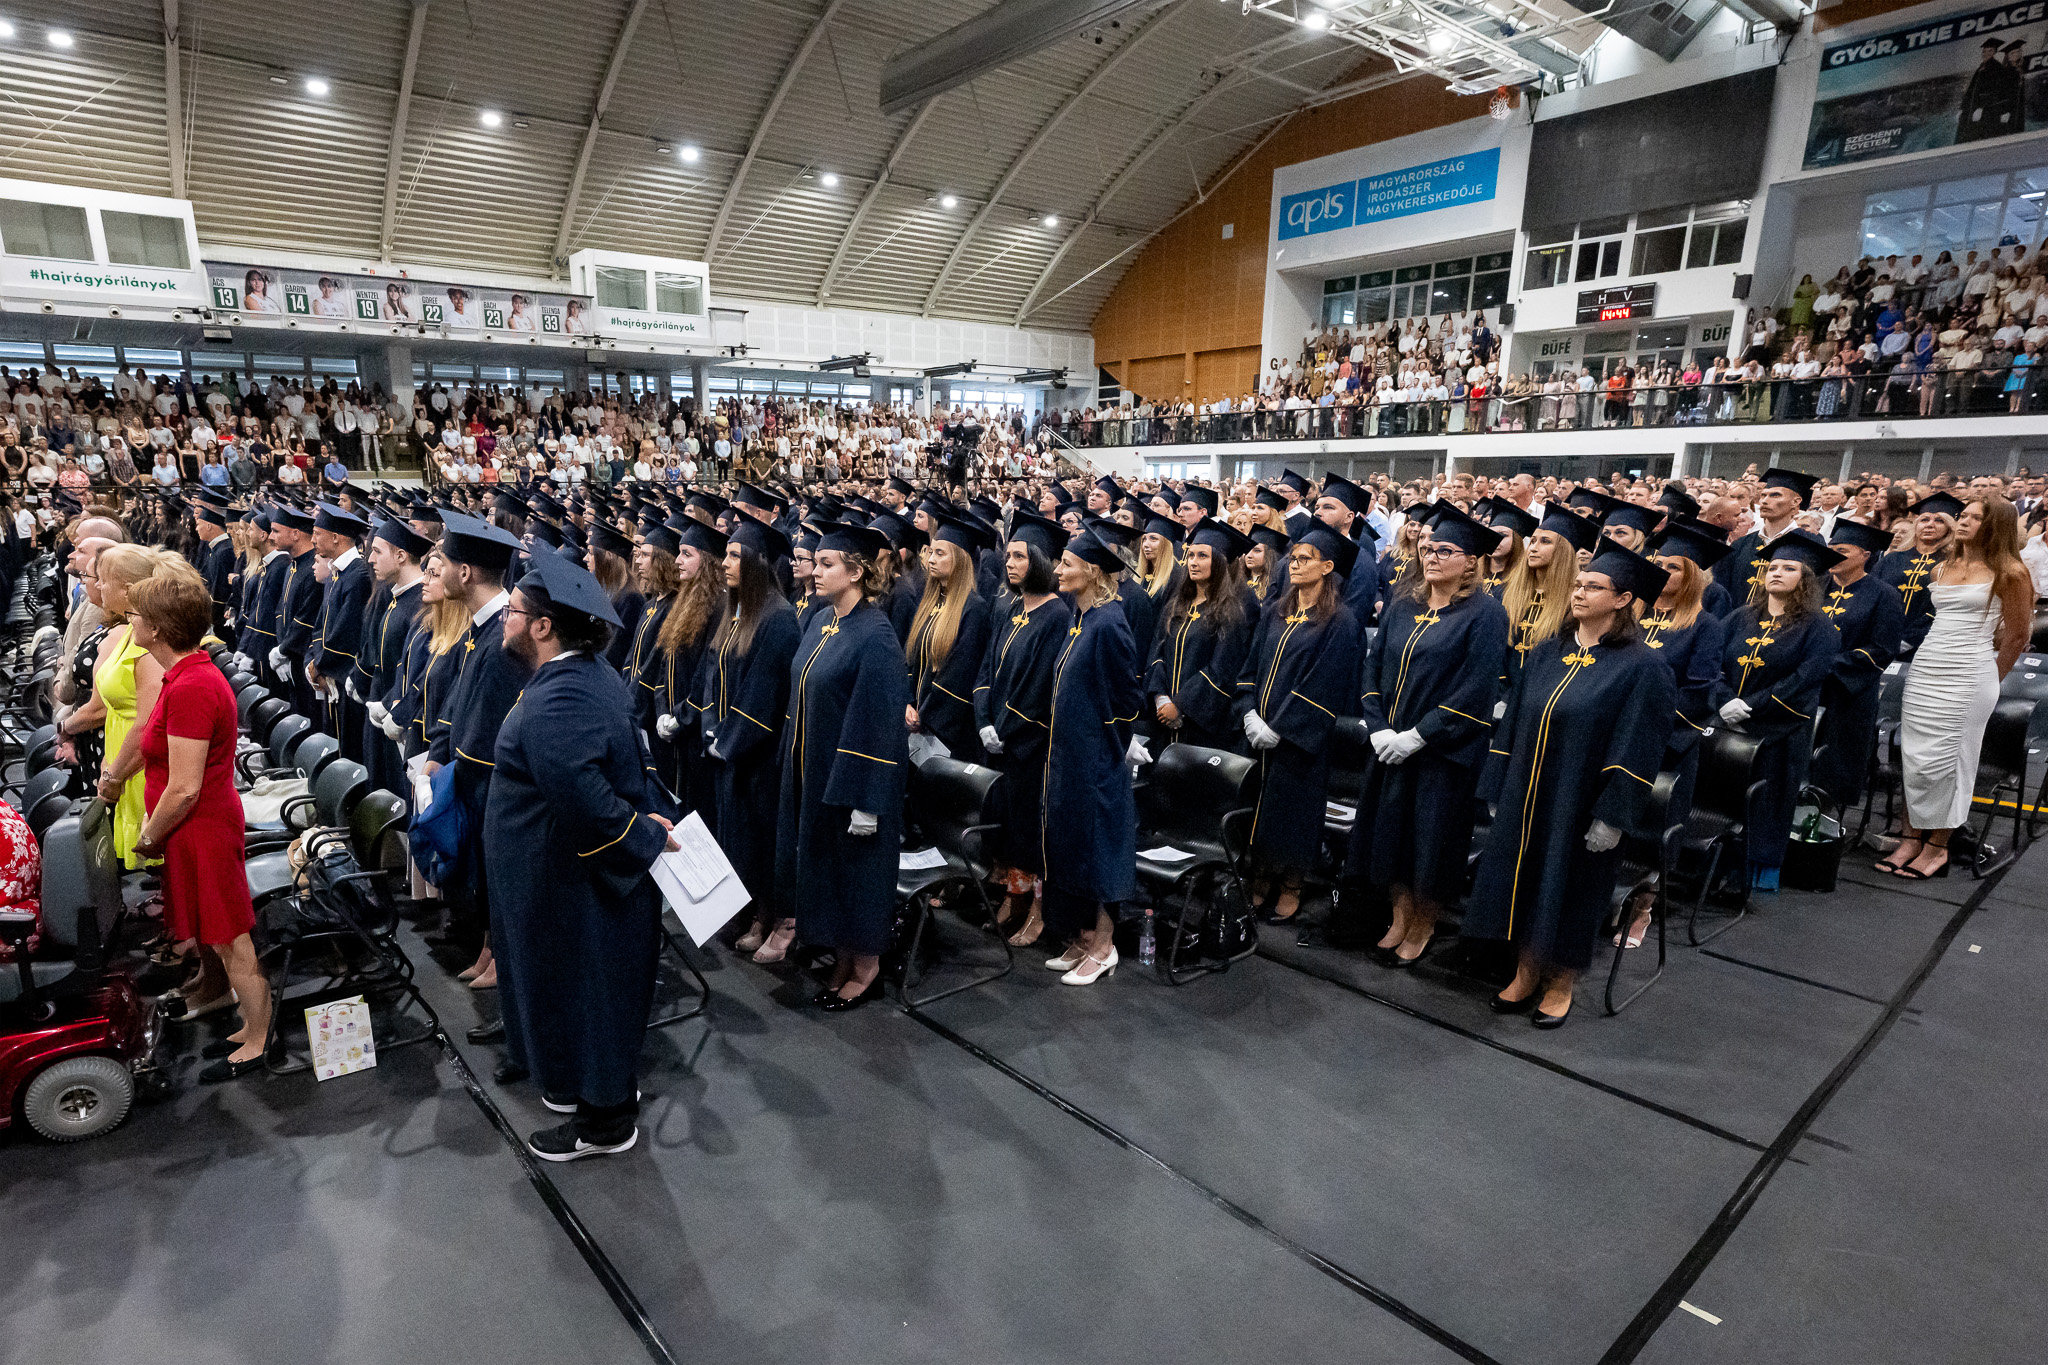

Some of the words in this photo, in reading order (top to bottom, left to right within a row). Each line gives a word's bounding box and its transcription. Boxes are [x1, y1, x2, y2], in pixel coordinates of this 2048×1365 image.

[1830, 38, 1899, 66] GYŐR,
[1906, 25, 1953, 48] THE
[1958, 2, 2046, 37] PLACE
[1844, 137, 1891, 151] EGYETEM
[1845, 128, 1902, 144] SZÉCHENYI
[1369, 161, 1465, 190] MAGYARORSZÁG
[1366, 184, 1483, 217] NAGYKERESKEDŐJE
[1368, 182, 1431, 204] IRODASZER
[1288, 190, 1345, 233] apis
[30, 269, 177, 291] #hajrágyőrilányok
[217, 288, 234, 307] 13
[290, 294, 306, 312] 14
[356, 290, 379, 300] WENTZEL
[1598, 294, 1607, 304] H
[1624, 291, 1632, 301] V
[360, 300, 375, 317] 19
[425, 305, 441, 322] 22
[1601, 308, 1630, 320] 14:44
[486, 310, 501, 326] 23
[544, 315, 558, 331] 33
[611, 317, 695, 332] #hajrágyőrilányok
[1541, 337, 1572, 355] BÜFÉ
